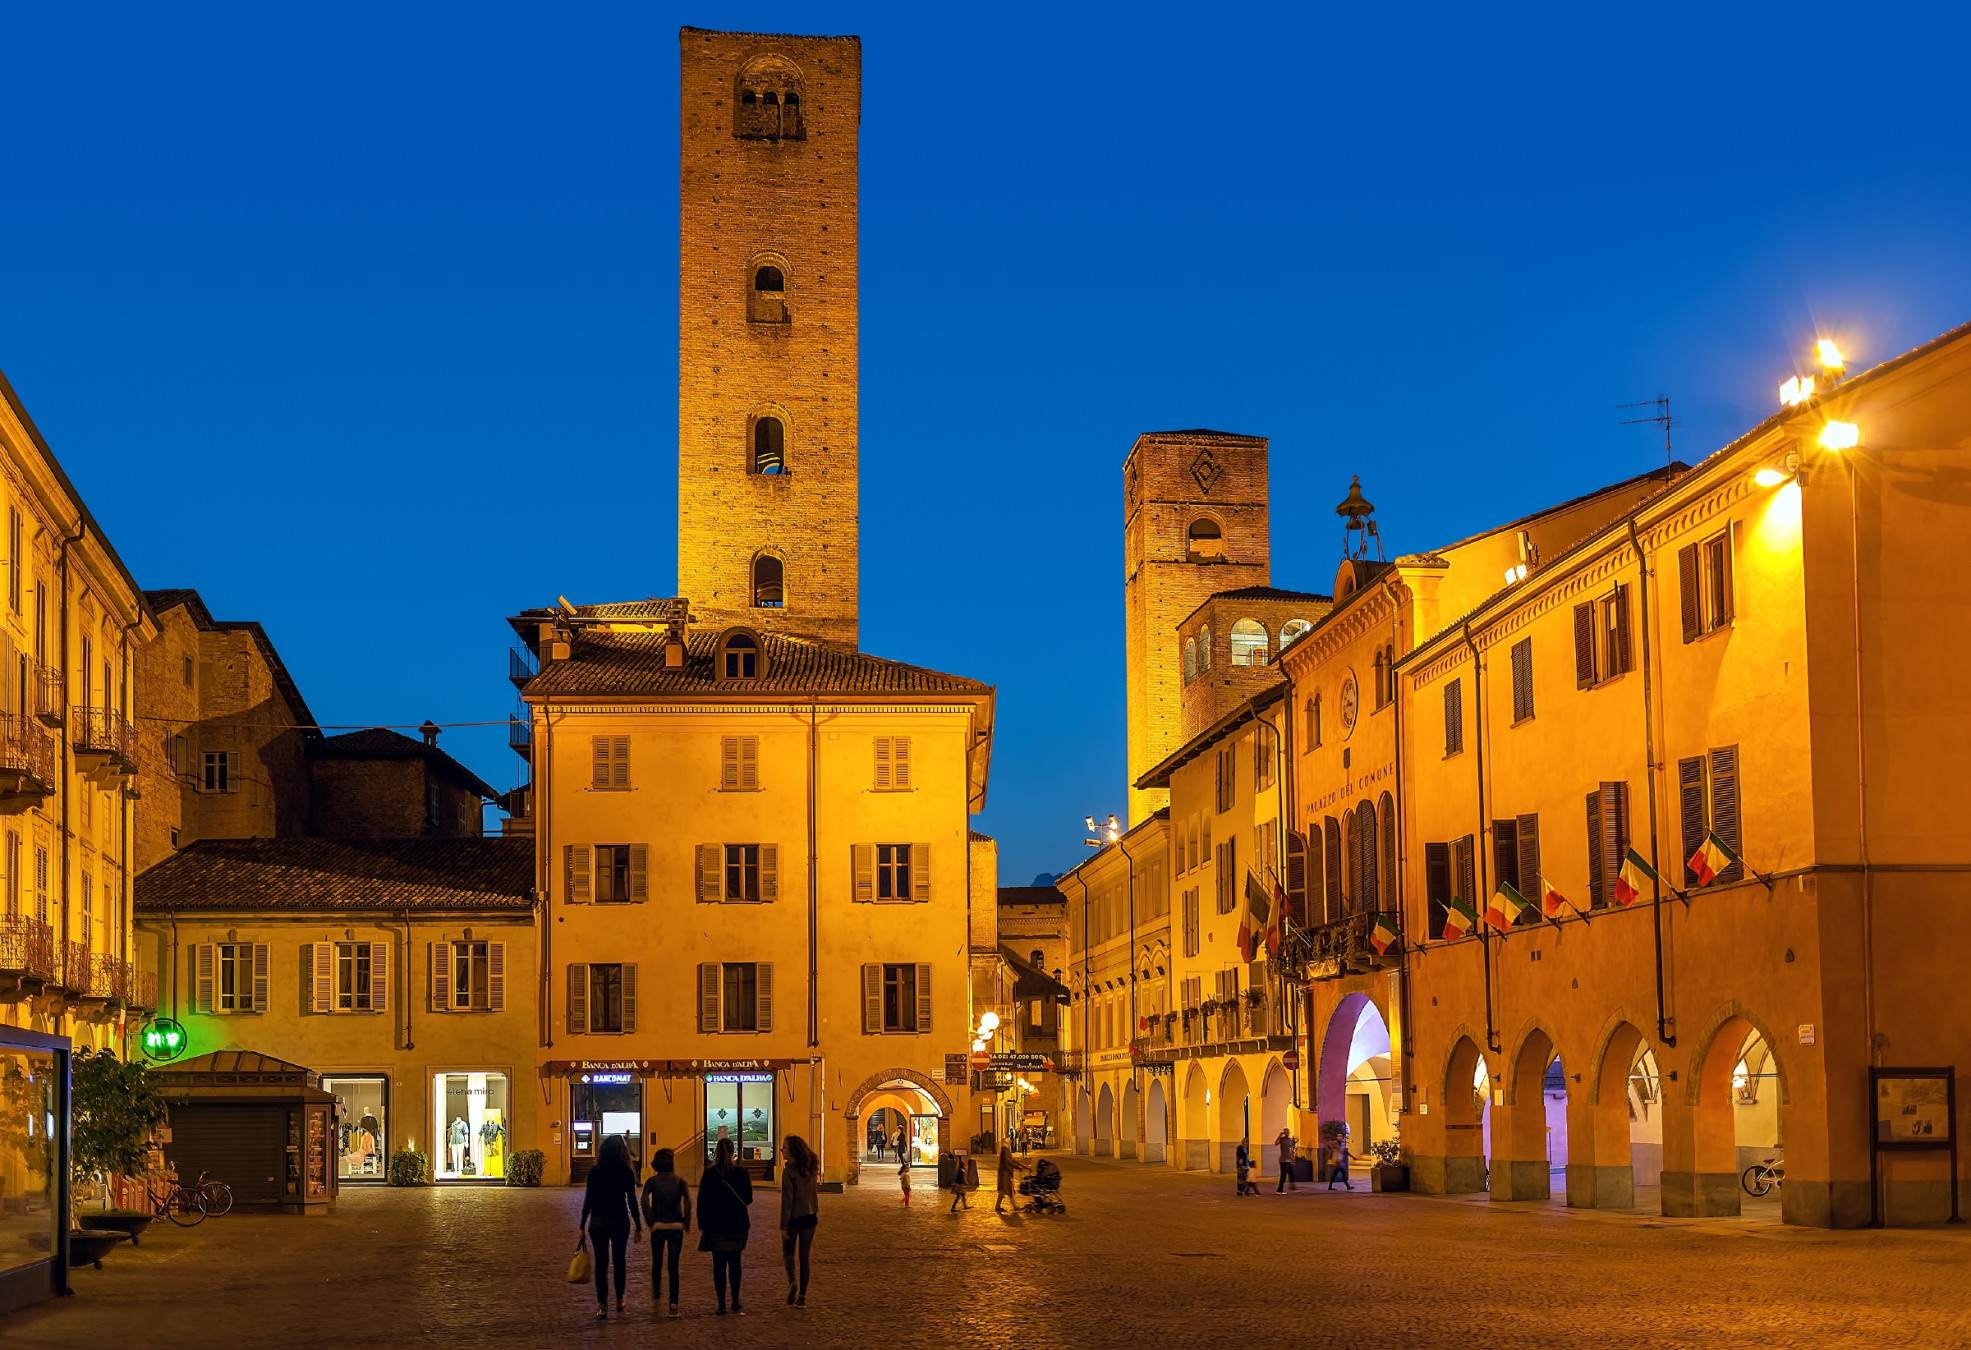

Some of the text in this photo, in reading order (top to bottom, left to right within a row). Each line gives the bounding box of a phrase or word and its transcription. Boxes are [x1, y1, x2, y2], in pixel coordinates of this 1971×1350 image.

[1306, 763, 1394, 815] PALAZZO DEL COMUNE
[582, 1061, 609, 1069] BANCA
[703, 1060, 730, 1068] BANCA
[593, 1074, 632, 1082] BANCOMAT
